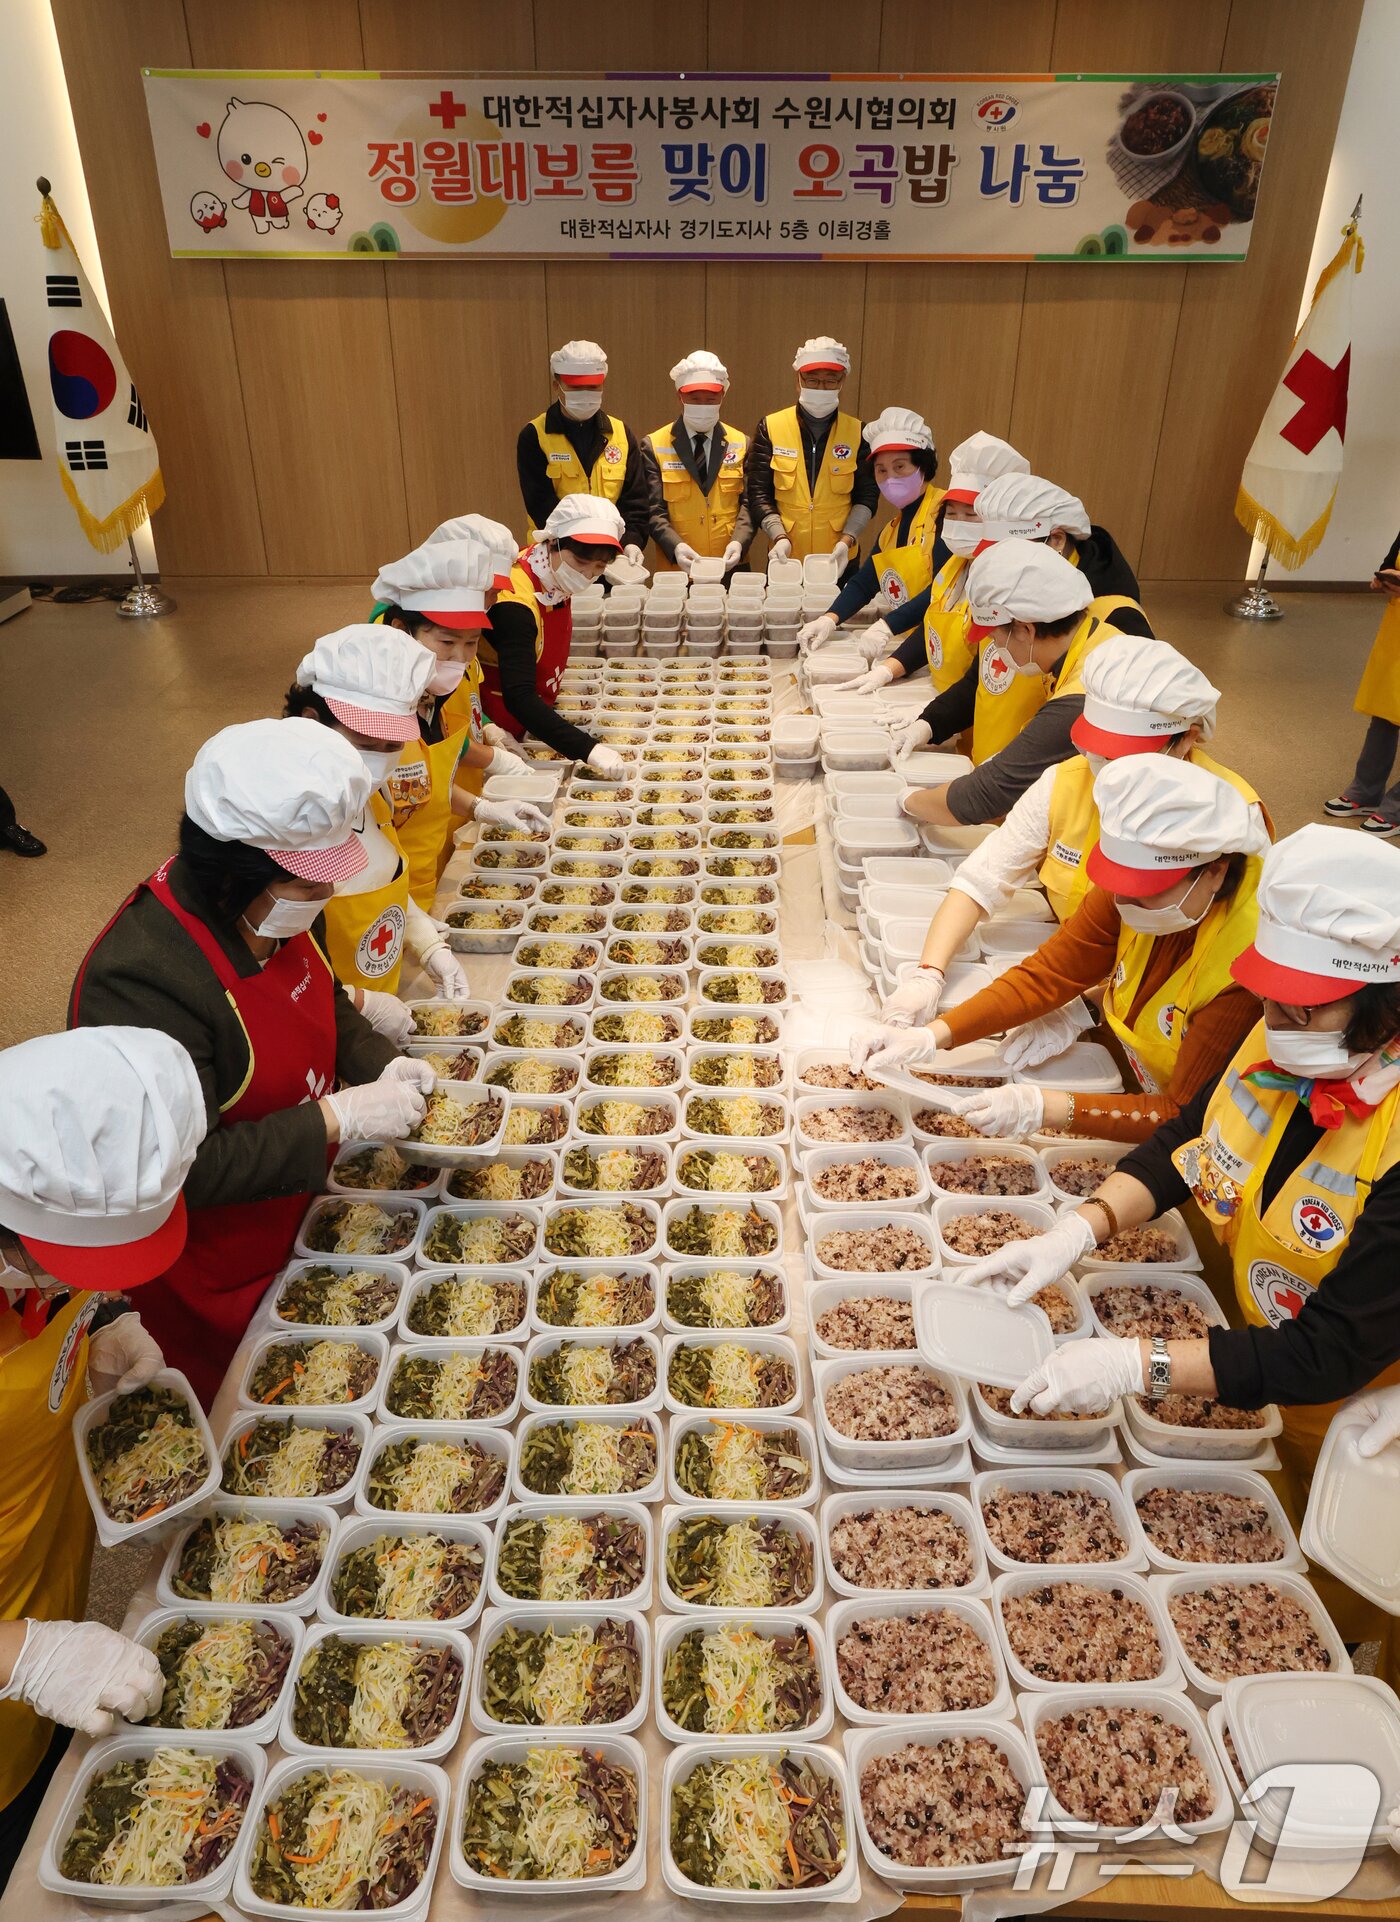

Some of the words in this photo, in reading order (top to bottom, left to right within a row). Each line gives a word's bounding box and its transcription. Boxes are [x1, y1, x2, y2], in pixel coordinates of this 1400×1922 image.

[483, 95, 760, 130] 대한적십자사봉사회
[771, 96, 957, 130] 수원시협의회
[367, 141, 638, 203] 정월대보름
[661, 143, 766, 203] 맞이
[792, 143, 957, 204] 오곡밥
[979, 143, 1085, 204] 나눔
[560, 218, 671, 239] 대한적십자사
[679, 219, 771, 240] 경기도지사
[779, 219, 810, 240] 5층
[818, 219, 892, 241] 이희경홀
[1150, 720, 1182, 730] 대한적십자사
[1154, 852, 1200, 863] 대한적십자사
[359, 918, 381, 952] KOREAN
[381, 909, 393, 921] RED
[392, 910, 403, 930] CROSS
[364, 946, 399, 973] 대한적십자사
[1332, 958, 1389, 973] 대한적십자사
[1302, 1198, 1321, 1207] KOREAN
[1320, 1202, 1329, 1214] RED
[1328, 1212, 1343, 1231] CROSS
[1255, 1266, 1281, 1290] KOREAN
[1281, 1272, 1307, 1292] RED
[53, 1322, 78, 1387] KOREAN
